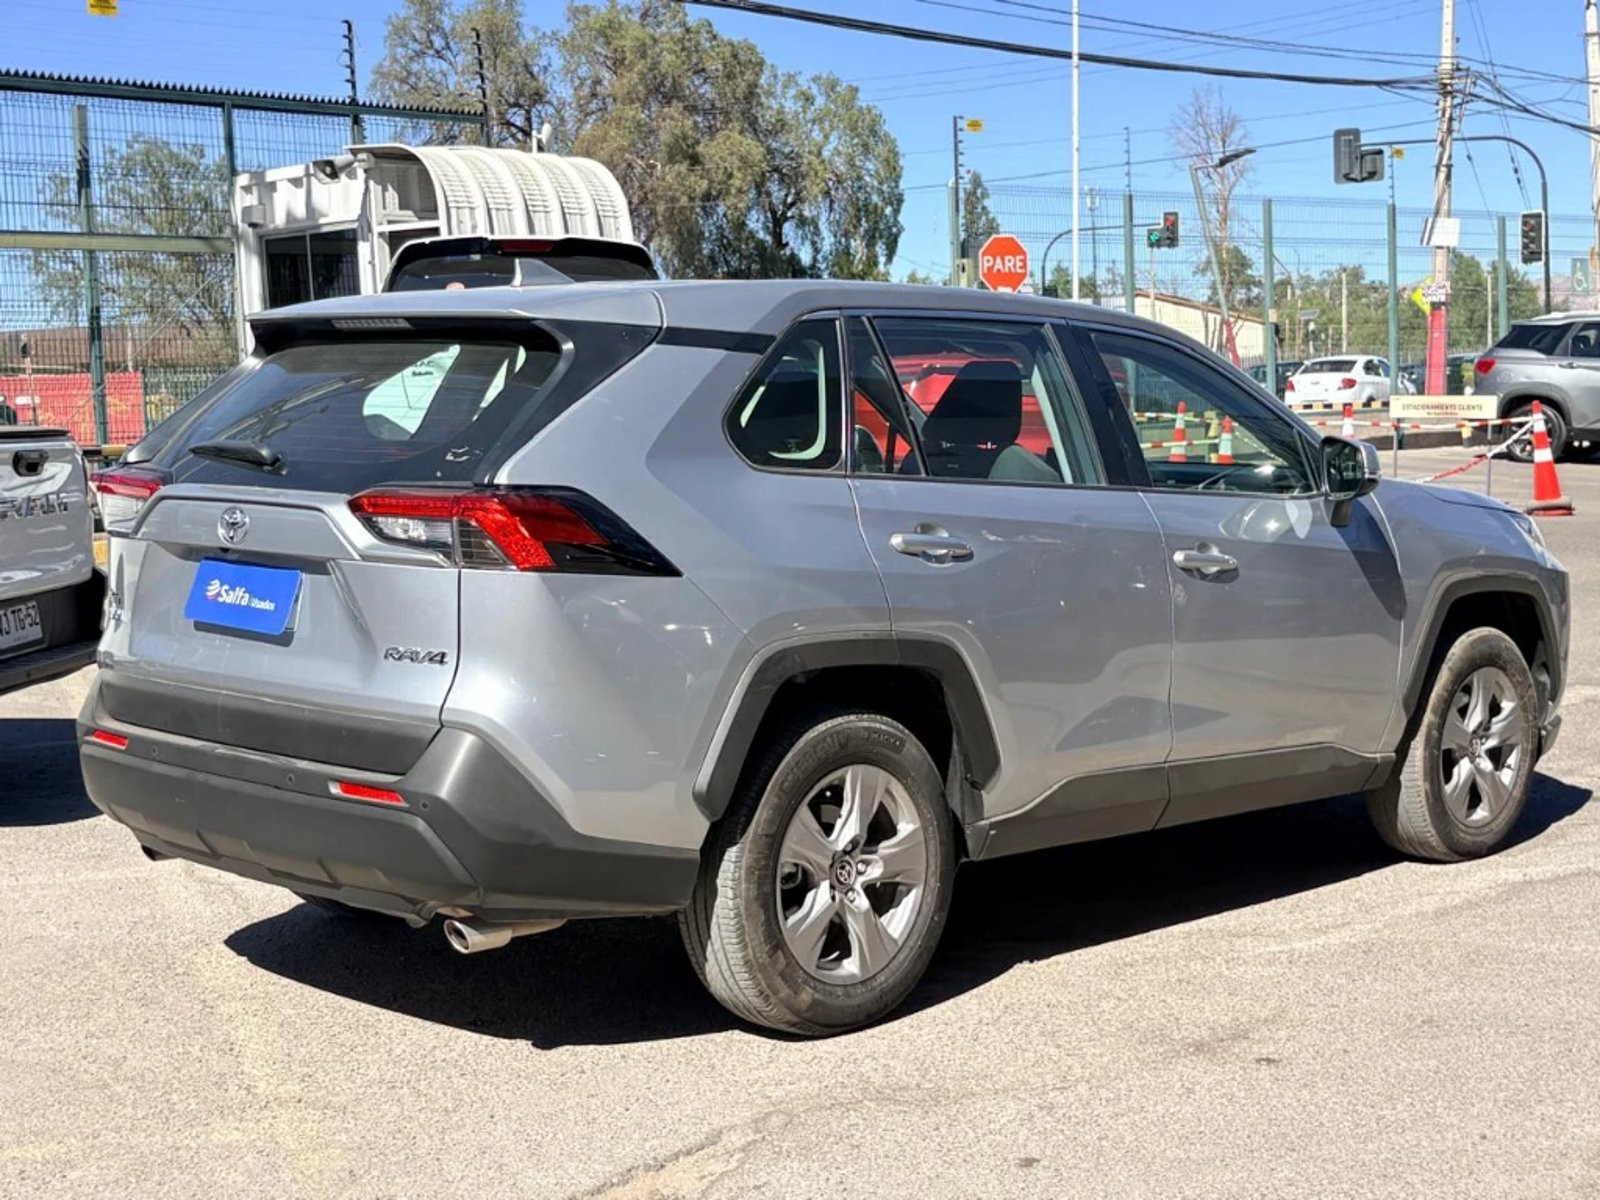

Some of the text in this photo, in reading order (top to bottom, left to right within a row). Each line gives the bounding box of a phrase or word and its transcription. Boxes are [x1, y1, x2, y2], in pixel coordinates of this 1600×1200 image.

[983, 255, 1026, 274] PARE
[1402, 403, 1457, 411] ESTACIONAMIENTO
[218, 584, 250, 606] Salfa
[383, 646, 449, 666] RAV4
